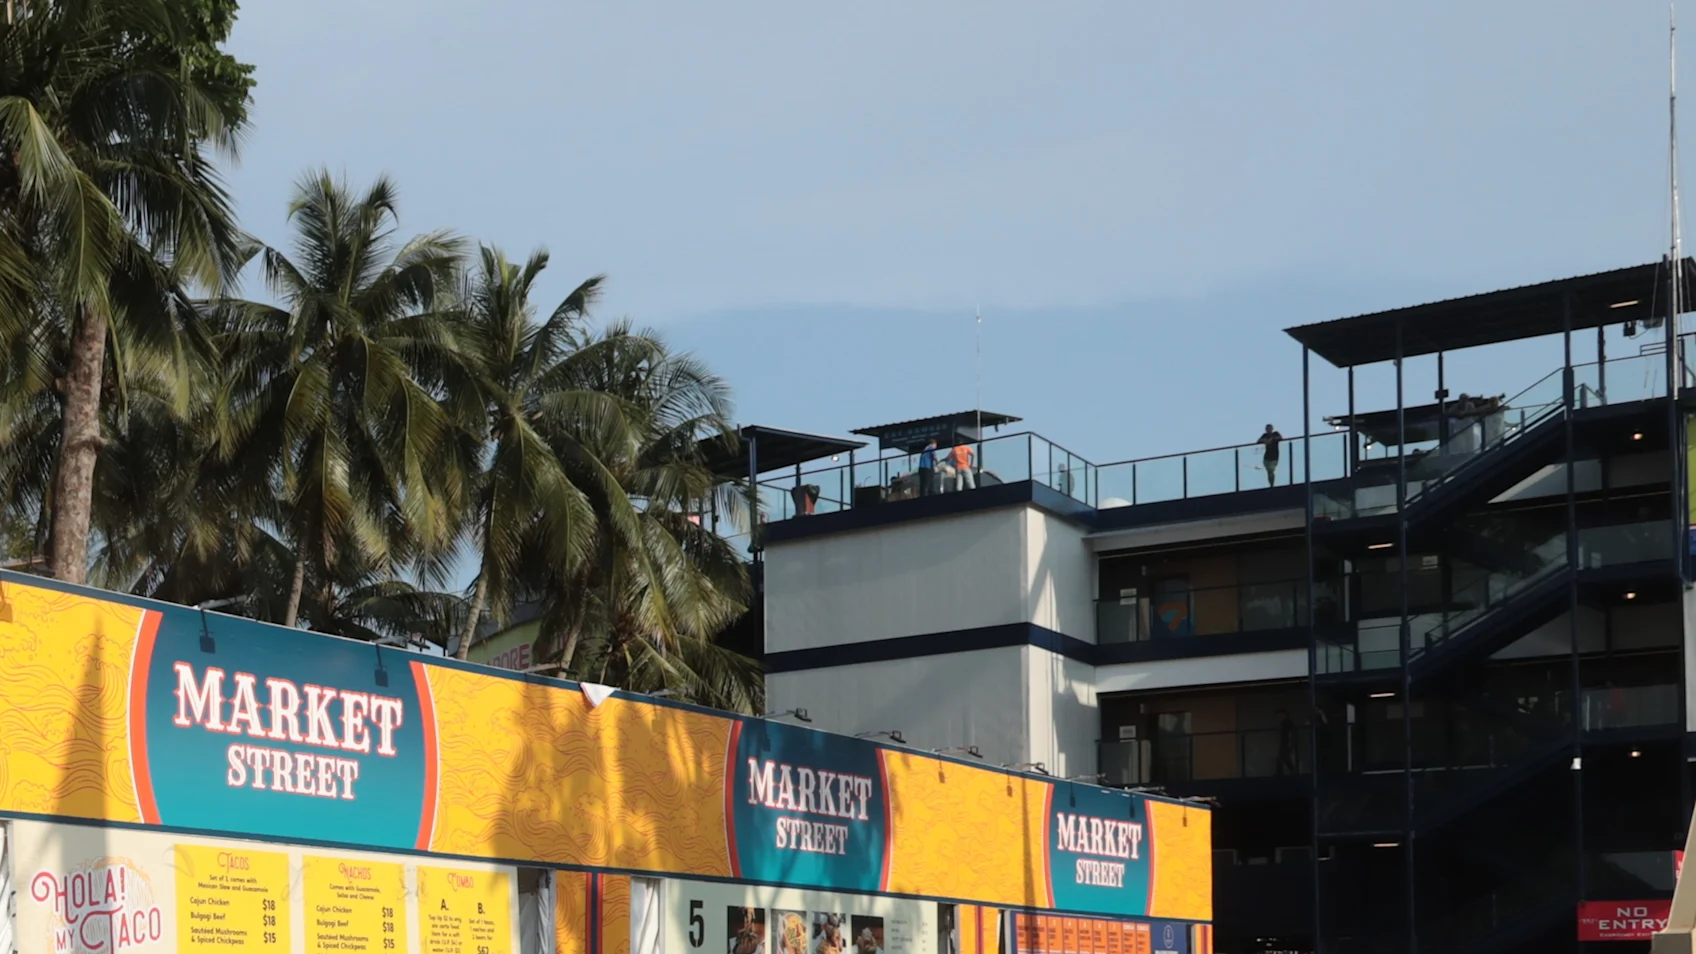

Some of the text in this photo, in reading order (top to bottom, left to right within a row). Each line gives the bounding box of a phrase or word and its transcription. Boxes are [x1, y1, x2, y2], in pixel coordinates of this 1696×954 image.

[173, 661, 403, 756] MARKET
[227, 743, 359, 800] STREET
[748, 757, 871, 821] MARKET
[776, 817, 847, 855] STREET
[1057, 812, 1142, 859] MARKET
[217, 852, 249, 873] TACOS
[1076, 859, 1124, 887] STREET
[32, 867, 125, 924] HOLA!
[190, 897, 230, 907] Cajun Chicken
[263, 899, 275, 911] $18
[191, 912, 211, 922] Bulgogi
[263, 914, 276, 927] $18
[1617, 907, 1648, 917] NO
[216, 928, 247, 936] Mushrooms
[689, 900, 704, 948] 5
[1599, 919, 1669, 930] ENTRY
[56, 929, 75, 951] MY
[264, 932, 276, 943] $15
